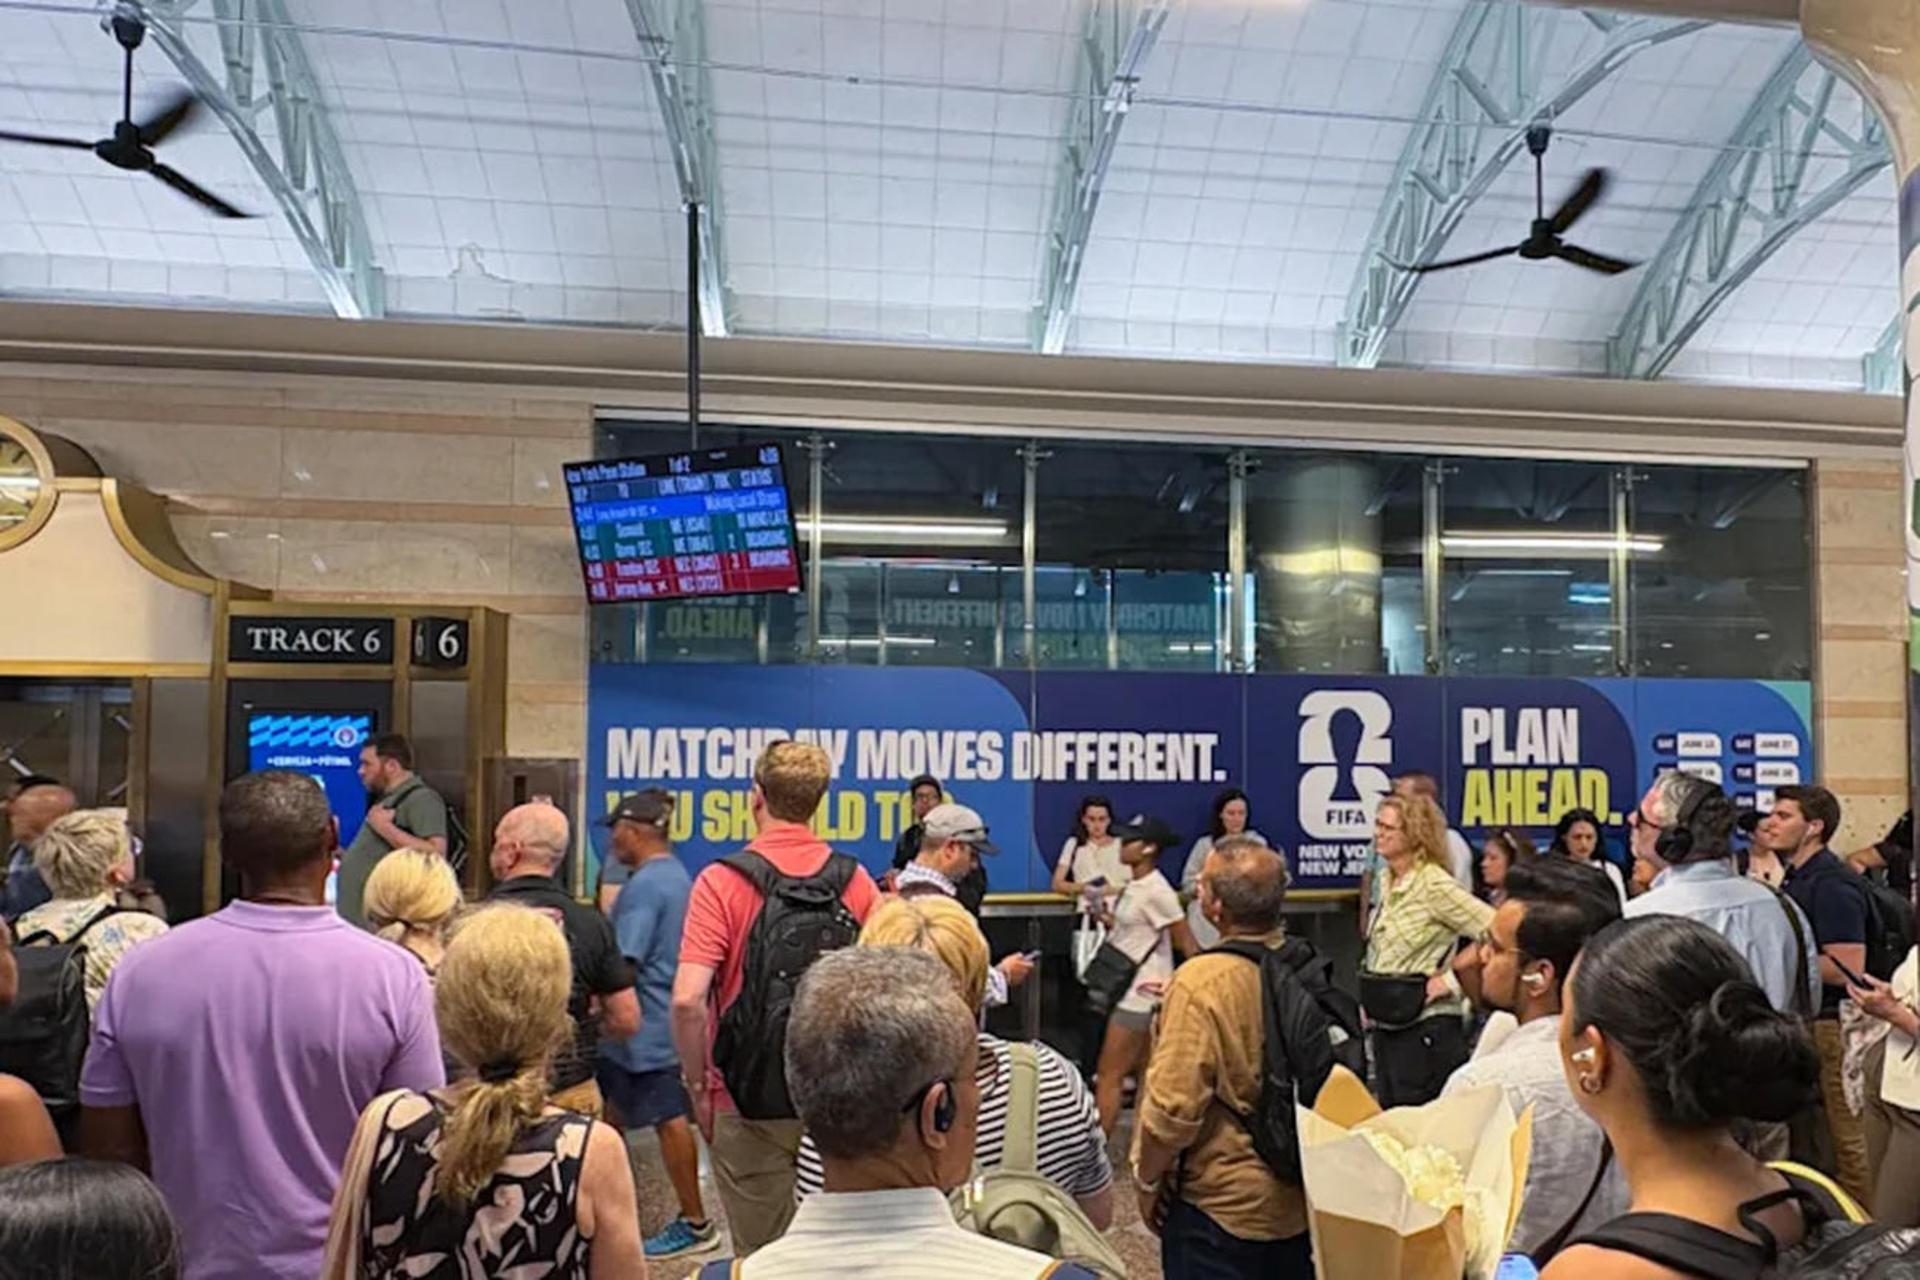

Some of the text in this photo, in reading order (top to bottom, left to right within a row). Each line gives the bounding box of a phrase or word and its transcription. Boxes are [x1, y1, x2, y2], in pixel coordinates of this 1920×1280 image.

[247, 627, 381, 653] TRACK 6
[438, 625, 459, 658] 6
[1462, 708, 1579, 764] PLAN
[607, 728, 1227, 781] MATCHY MOVES DIFFERENT.
[1462, 769, 1623, 825] AHEAD.
[1326, 810, 1366, 825] FIFA
[1298, 845, 1340, 860] NEW
[1298, 860, 1340, 876] NEW
